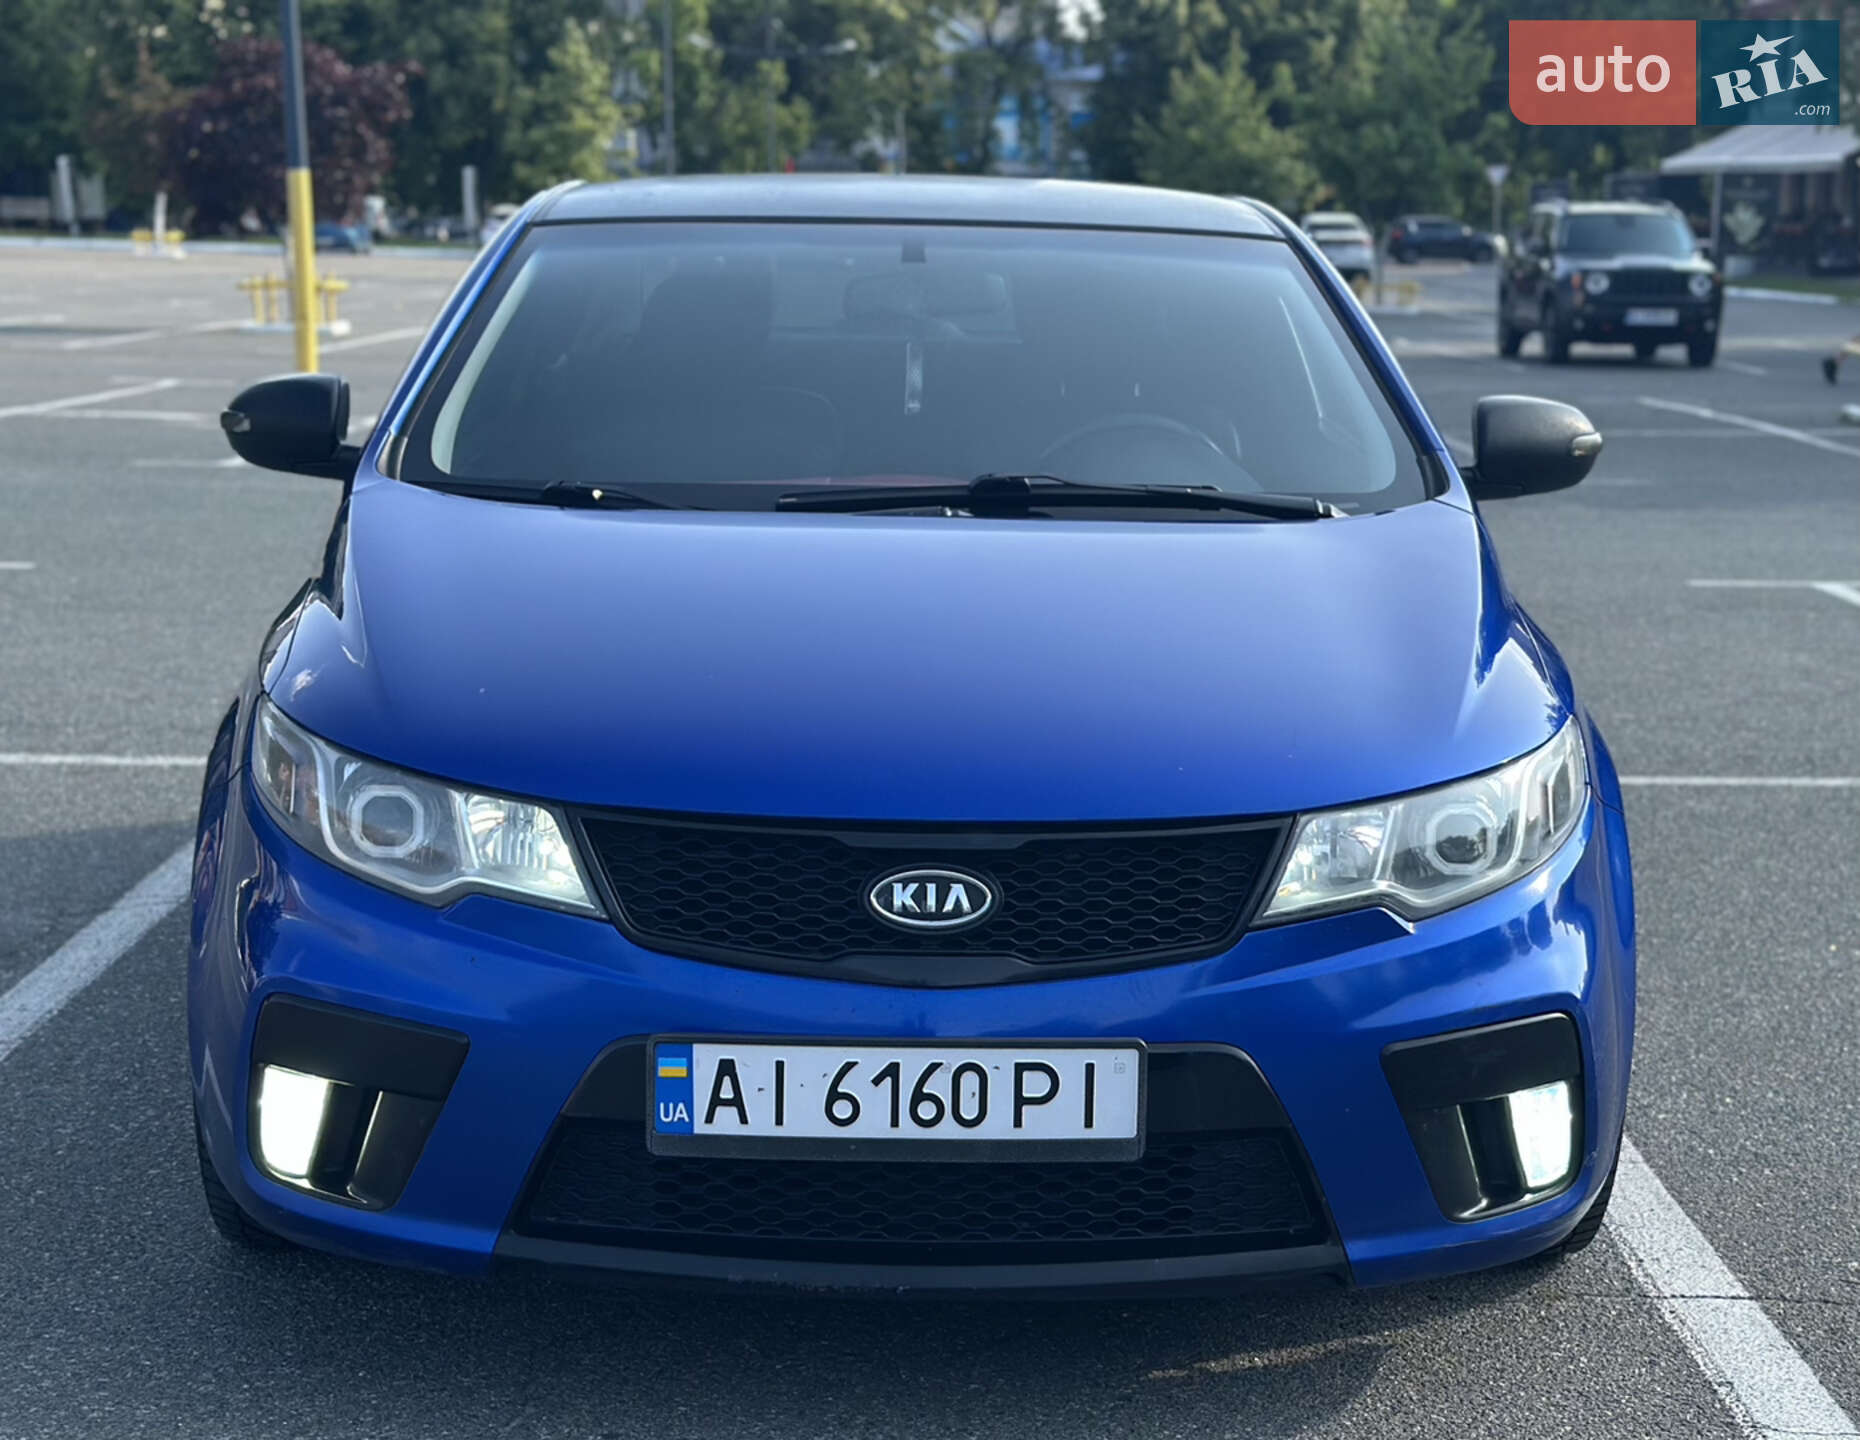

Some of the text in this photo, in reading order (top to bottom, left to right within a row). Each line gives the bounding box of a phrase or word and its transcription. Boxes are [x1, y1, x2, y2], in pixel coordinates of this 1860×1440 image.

[891, 882, 973, 913] KIA
[703, 1058, 1096, 1129] AI 6160 PI
[659, 1101, 690, 1123] UA
